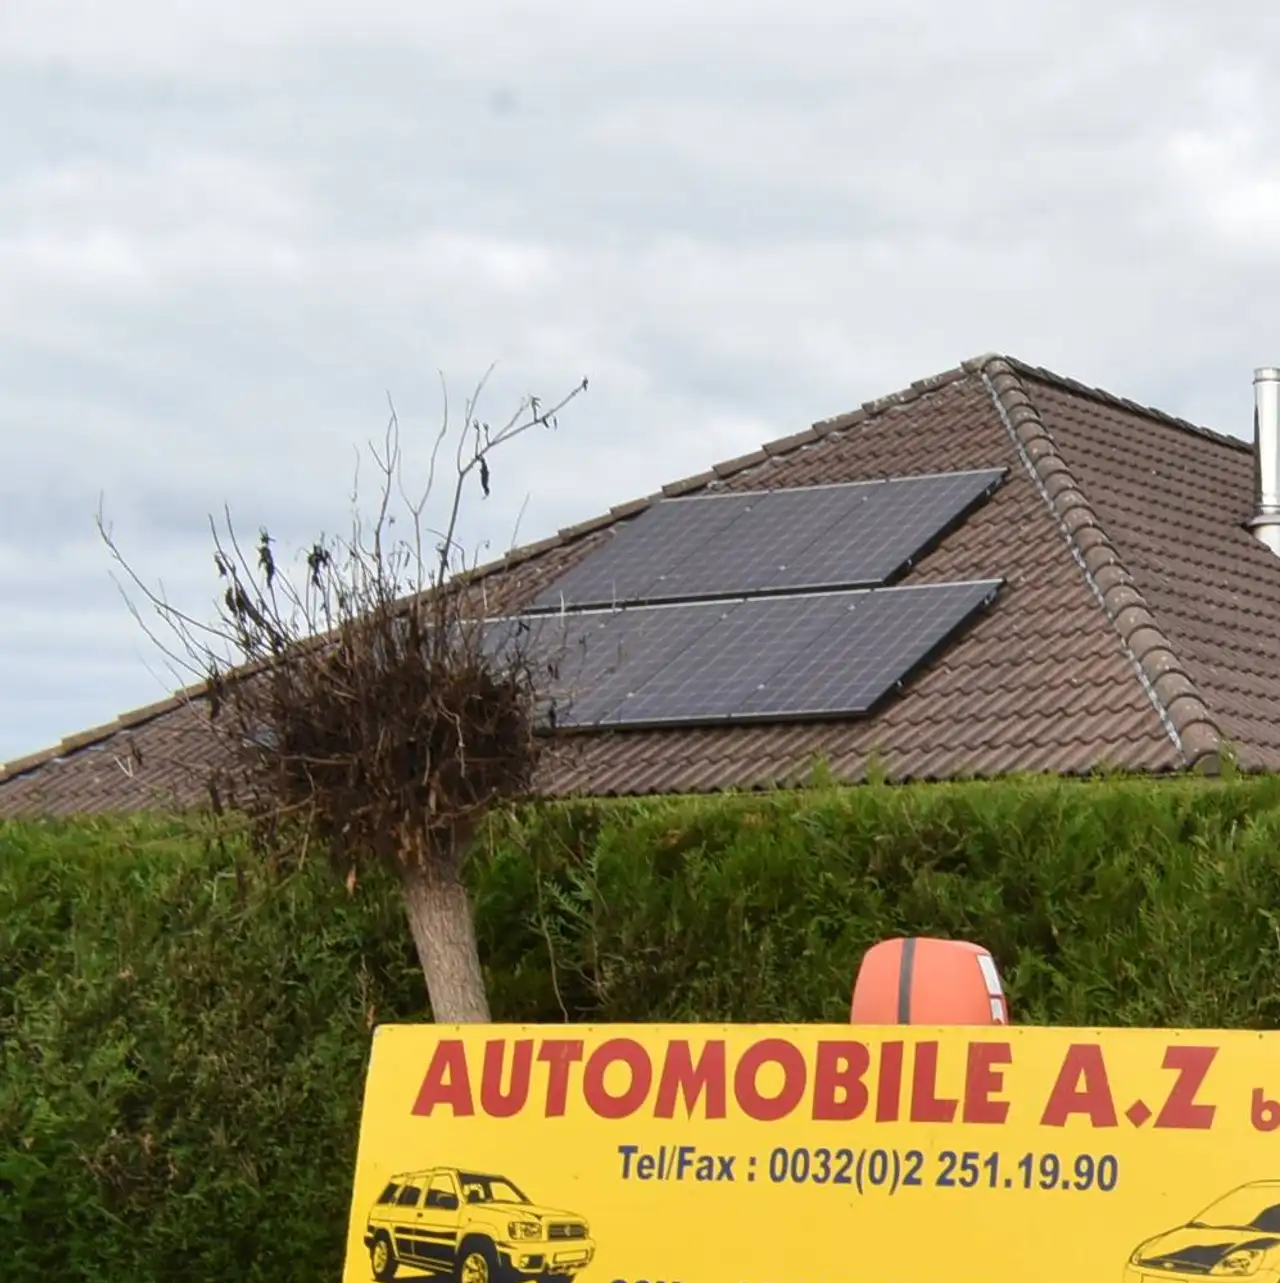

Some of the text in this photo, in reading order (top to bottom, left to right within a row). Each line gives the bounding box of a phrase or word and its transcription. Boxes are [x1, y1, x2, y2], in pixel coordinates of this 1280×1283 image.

[411, 1037, 1013, 1125] AUTOMOBILE
[1039, 1043, 1219, 1130] A.Z
[617, 1145, 736, 1182] Tel/Fax
[769, 1147, 924, 1196] 0032(0)2
[935, 1150, 1118, 1192] 251.19.90
